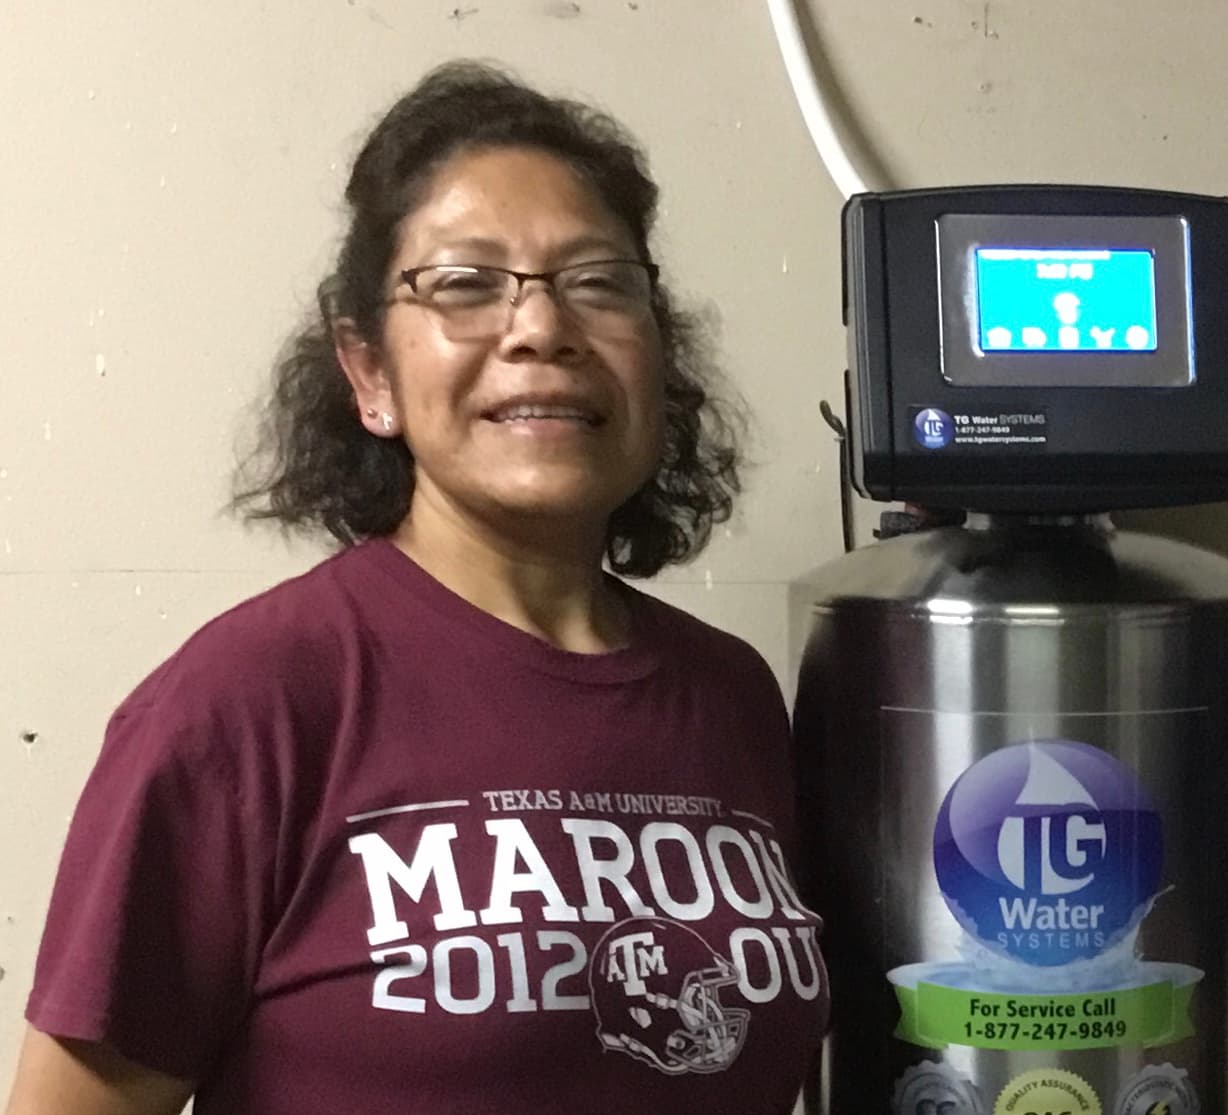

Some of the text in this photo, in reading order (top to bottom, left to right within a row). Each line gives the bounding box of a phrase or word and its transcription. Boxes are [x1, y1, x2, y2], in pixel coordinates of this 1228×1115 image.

[954, 414, 1046, 425] TG Water SYSTEMS
[482, 789, 724, 818] TEXAS A&M UNIVERSITY
[347, 817, 823, 946] MAROON
[998, 896, 1105, 931] Water
[997, 932, 1106, 949] SYSTEMS
[371, 926, 830, 1015] 2012 OU
[970, 997, 1116, 1018] For Service Call
[963, 1020, 1127, 1041] 1-877-247-9849
[1006, 1080, 1039, 1112] QUALITY
[1041, 1079, 1090, 1112] ASSURANCE
